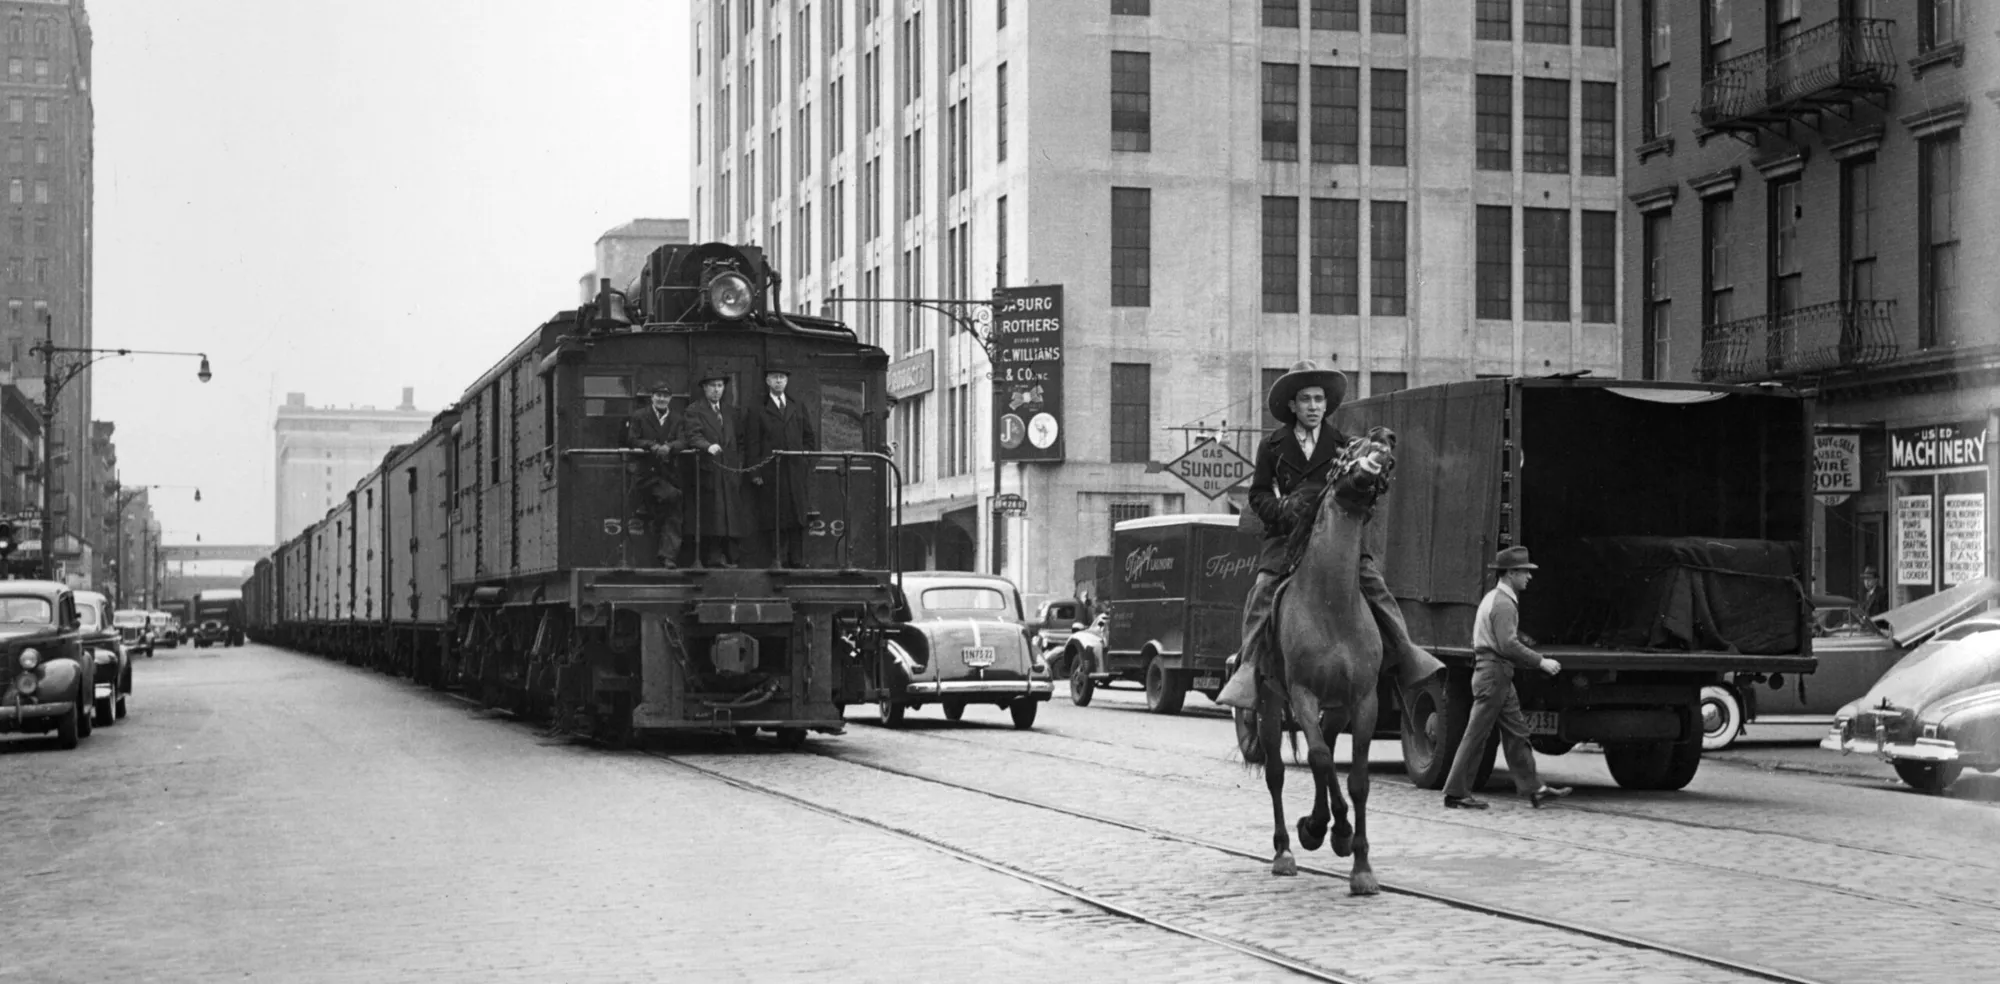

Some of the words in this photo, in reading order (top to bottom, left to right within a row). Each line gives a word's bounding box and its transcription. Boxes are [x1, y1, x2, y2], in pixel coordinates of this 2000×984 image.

[1002, 318, 1060, 333] ROTHERS
[1202, 448, 1223, 459] GAS
[1892, 428, 1987, 468] MACHINERY
[1181, 460, 1244, 478] SUNOCO
[1203, 482, 1221, 491] OIL
[1205, 552, 1257, 580] Tippy
